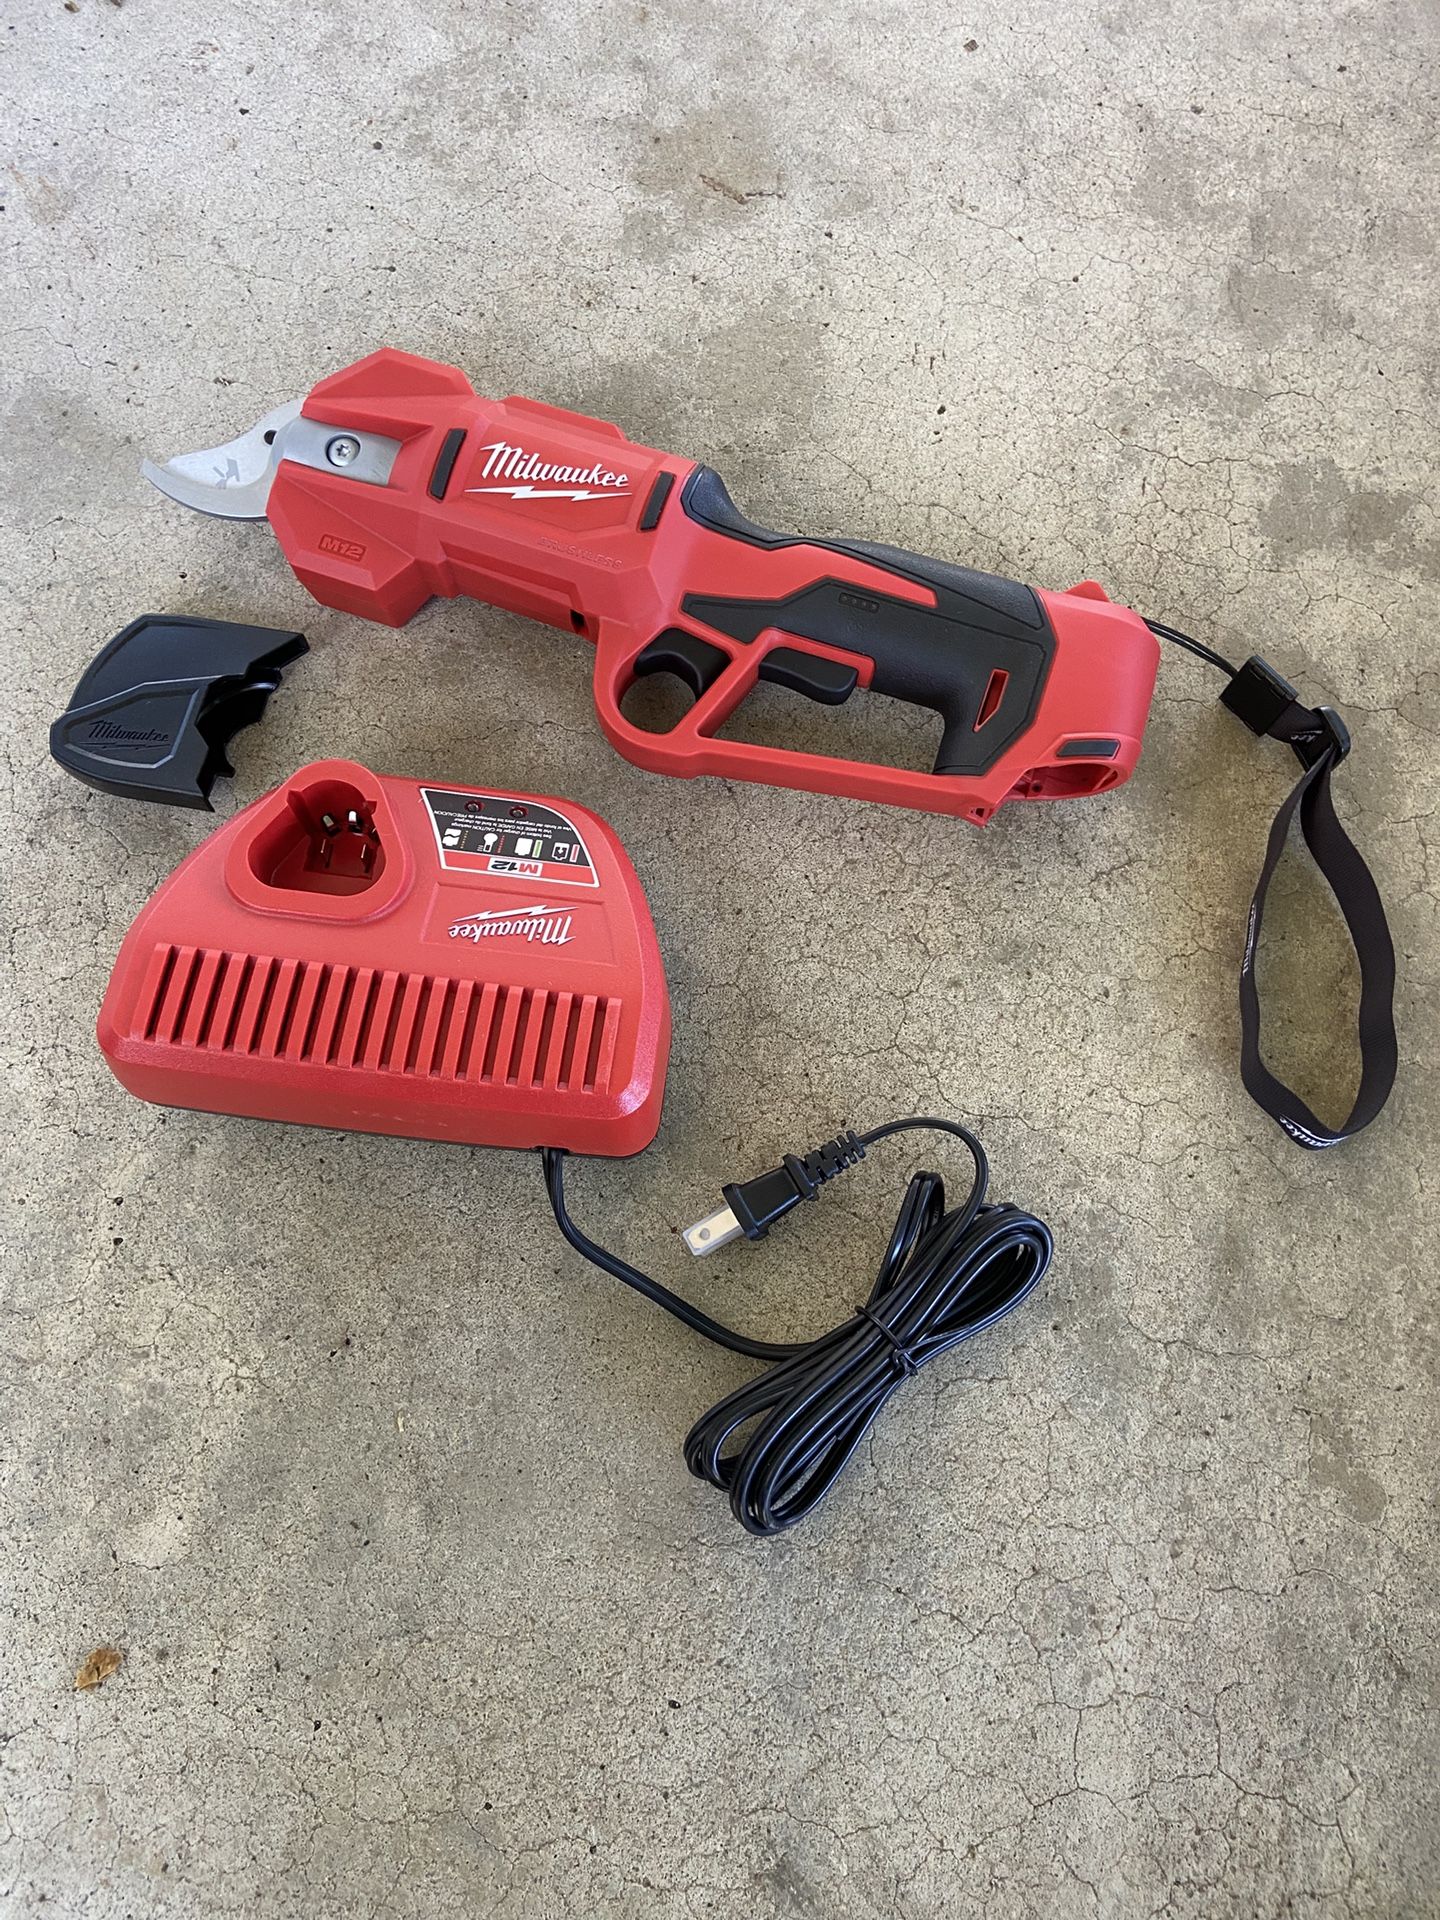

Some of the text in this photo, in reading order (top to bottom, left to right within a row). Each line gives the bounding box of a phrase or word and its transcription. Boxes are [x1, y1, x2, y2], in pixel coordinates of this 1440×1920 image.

[480, 441, 630, 488] Milwaukee
[320, 536, 363, 559] M12
[537, 536, 624, 568] BRUSHLESS
[88, 719, 169, 742] Milwaukee
[491, 860, 540, 875] M12
[448, 915, 576, 946] Milwaukee
